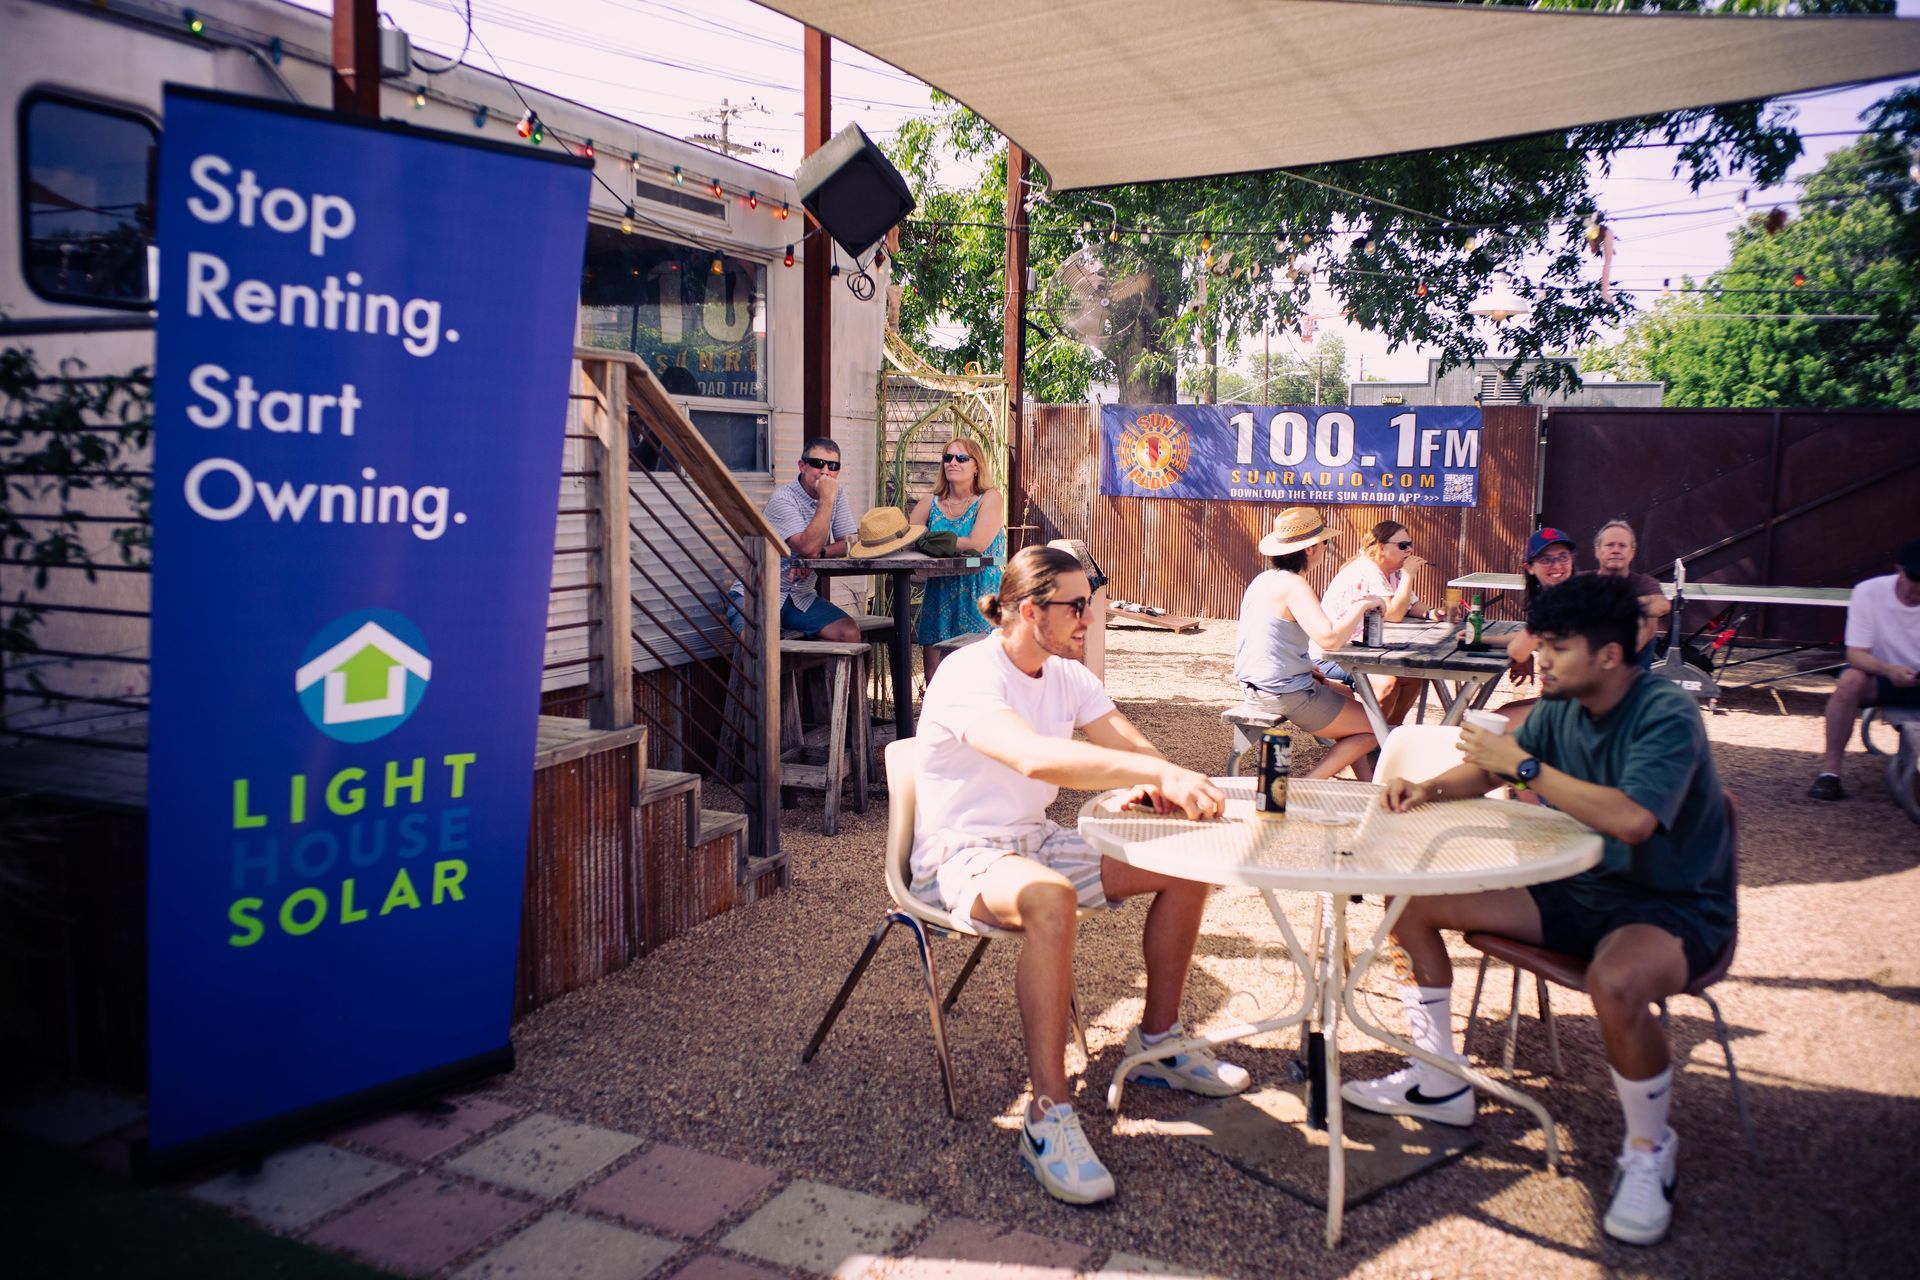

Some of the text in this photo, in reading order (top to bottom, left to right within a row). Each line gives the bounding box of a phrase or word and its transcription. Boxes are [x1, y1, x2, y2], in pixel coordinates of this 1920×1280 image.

[186, 154, 356, 256] Stop
[186, 251, 460, 357] Renting.
[186, 363, 361, 437] Start
[1136, 413, 1176, 432] SUN
[184, 457, 467, 540] Owning.
[1127, 467, 1179, 490] RADIO
[1230, 488, 1420, 502] DOWNLOAD THE FREE SUN RADIO APP
[233, 753, 477, 829] LIGHT
[231, 807, 472, 889] HOUSE
[228, 859, 468, 947] SOLAR
